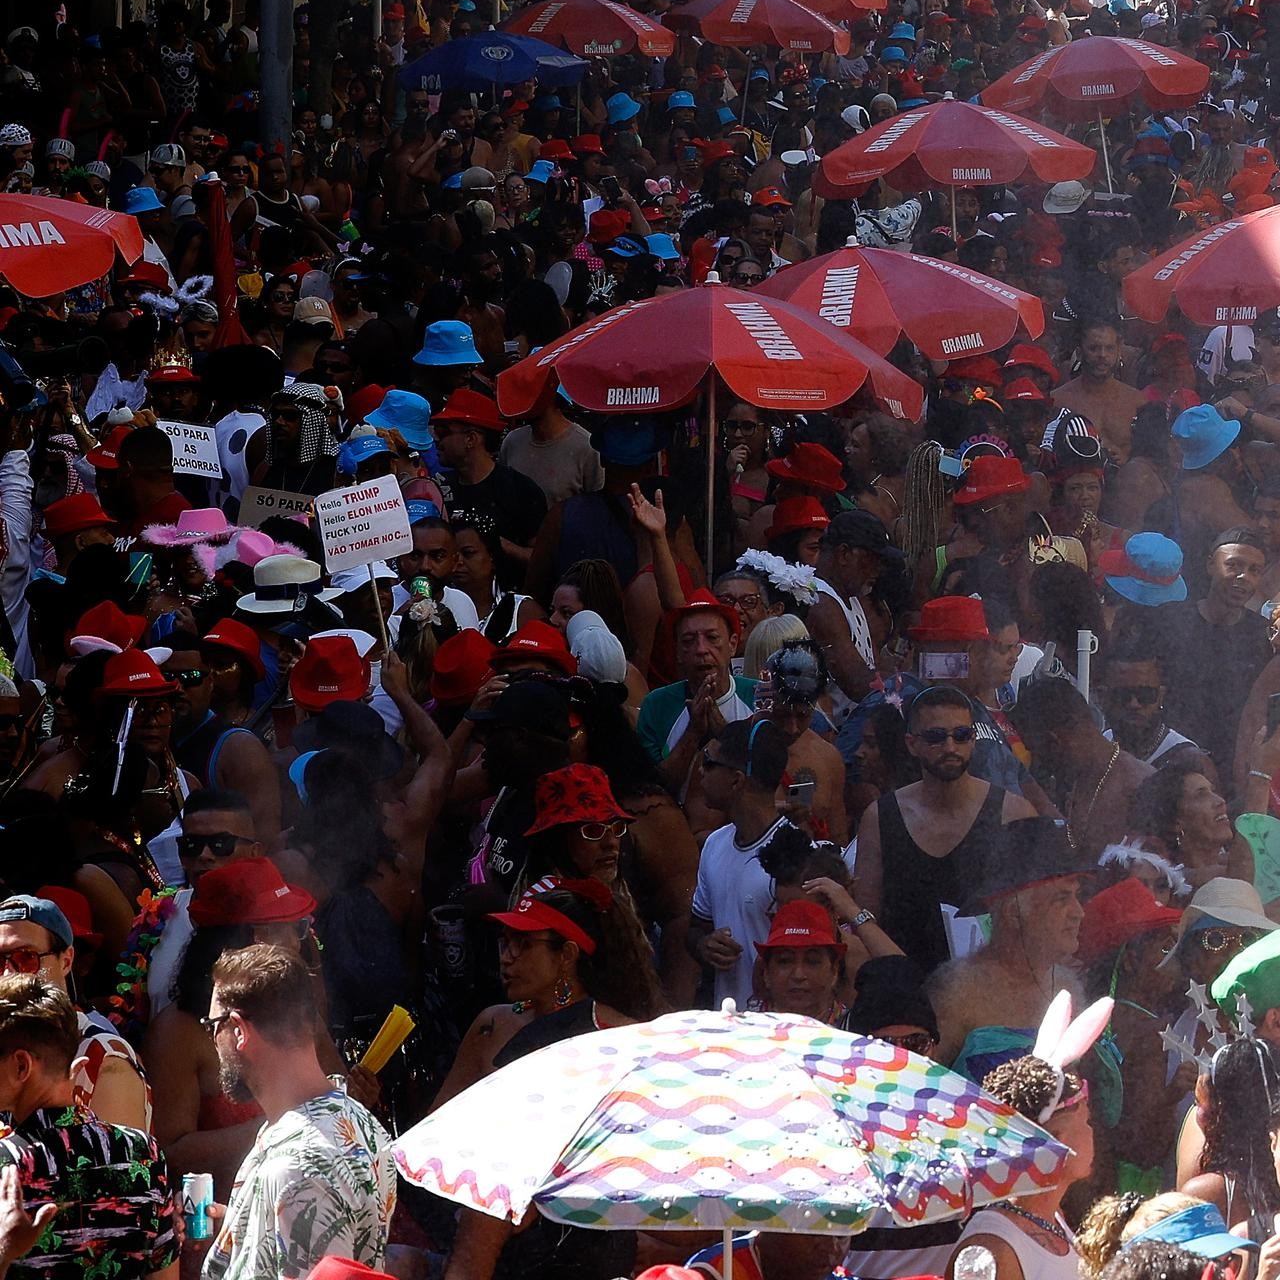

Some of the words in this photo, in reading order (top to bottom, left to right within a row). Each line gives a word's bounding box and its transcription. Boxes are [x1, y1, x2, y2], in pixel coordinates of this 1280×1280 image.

[584, 43, 614, 55] BRAHMA
[1081, 84, 1116, 97] BRAHMA
[952, 167, 992, 180] BRAHMA
[819, 265, 860, 327] BRAHMA
[1215, 305, 1257, 321] BRAHMA
[724, 302, 804, 361] BRAHMA
[942, 332, 984, 355] BRAHMA
[607, 387, 660, 406] BRAHMA
[165, 425, 181, 437] SÓ
[183, 428, 210, 442] PARA
[184, 444, 197, 455] AS
[173, 457, 220, 473] ACHORRAS
[256, 494, 275, 507] SÓ
[278, 497, 313, 514] PARA
[320, 499, 342, 512] Hello
[342, 486, 379, 505] TRUMP
[323, 514, 346, 526] Hello
[347, 506, 373, 521] ELON
[373, 498, 400, 514] MUSK
[325, 525, 351, 540] FUCK
[350, 522, 370, 535] YOU
[327, 543, 347, 556] VÃO
[348, 538, 380, 552] TOMAR
[380, 534, 393, 546] NO
